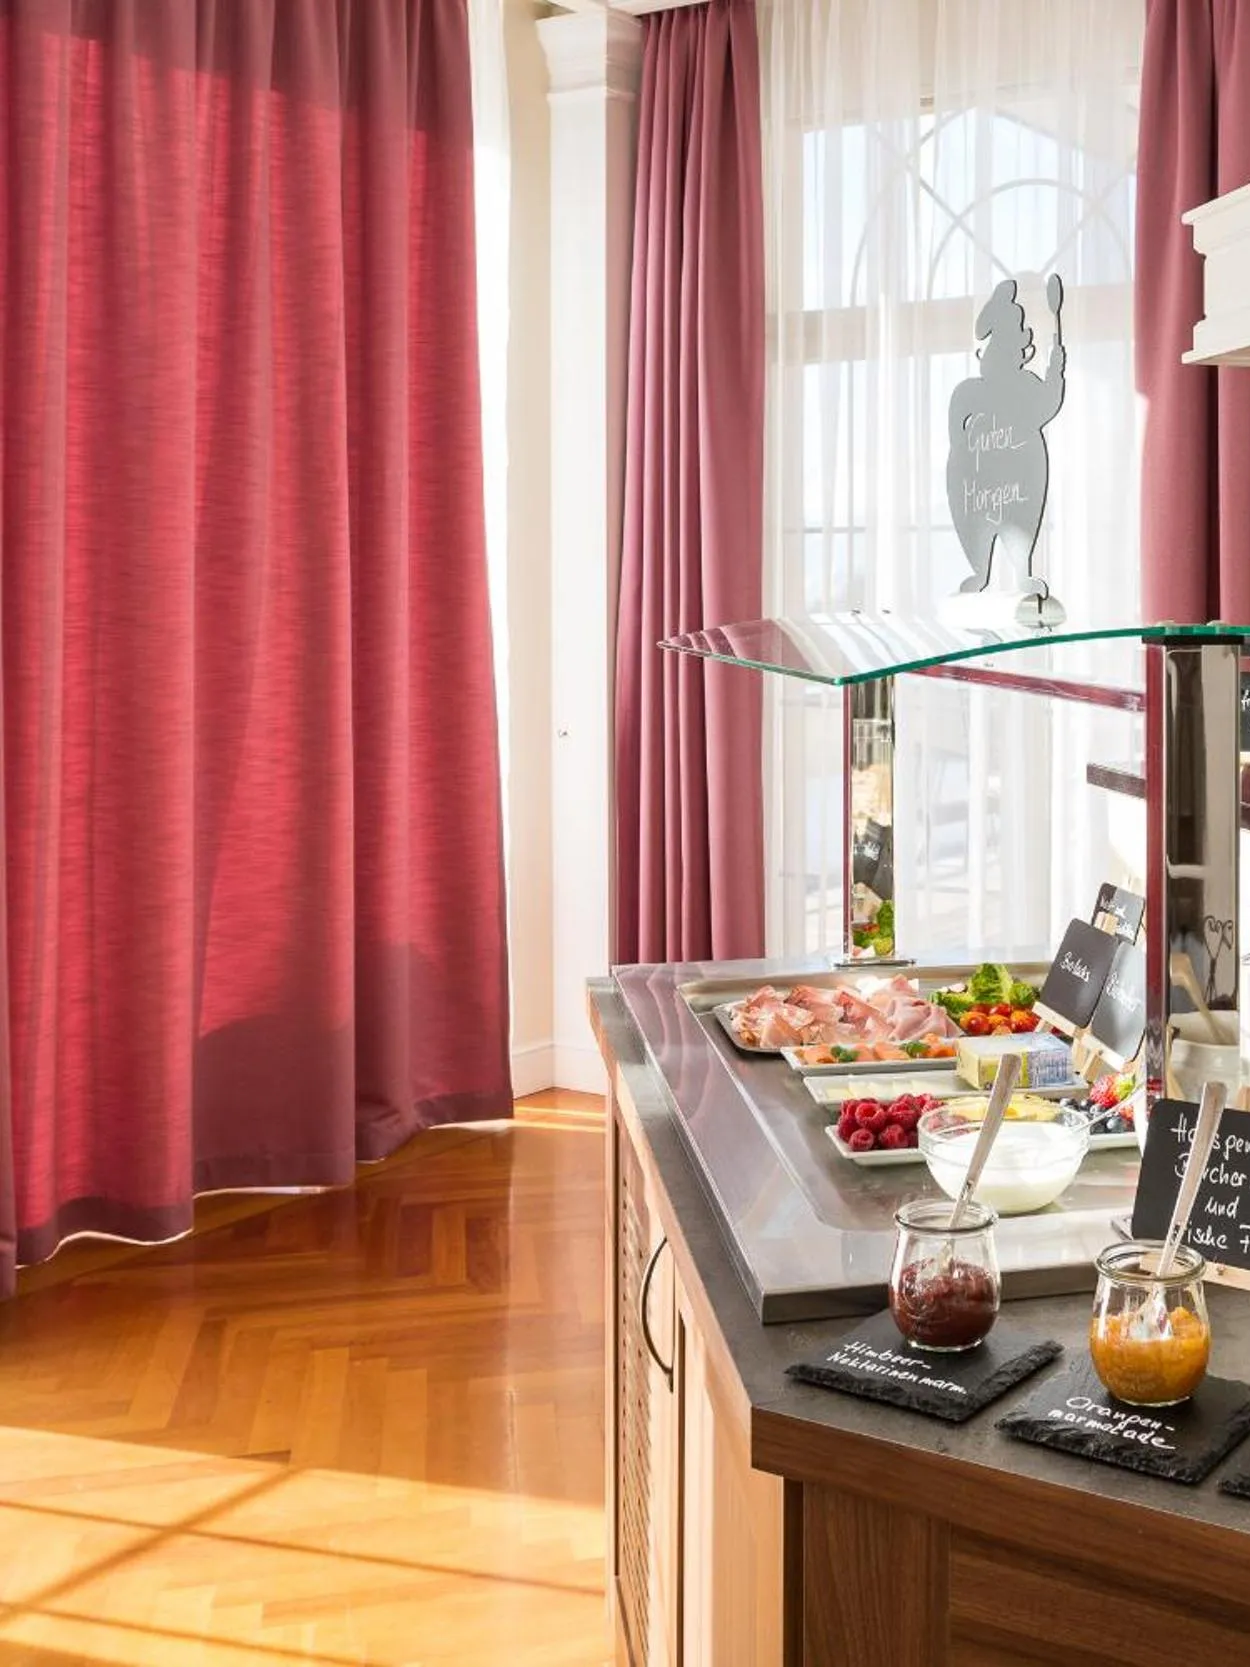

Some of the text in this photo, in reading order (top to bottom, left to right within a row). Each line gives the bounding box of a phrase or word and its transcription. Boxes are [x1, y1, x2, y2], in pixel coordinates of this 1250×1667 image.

[968, 412, 1027, 472] Guten
[963, 478, 1028, 525] Morgen
[1205, 1196, 1239, 1219] und
